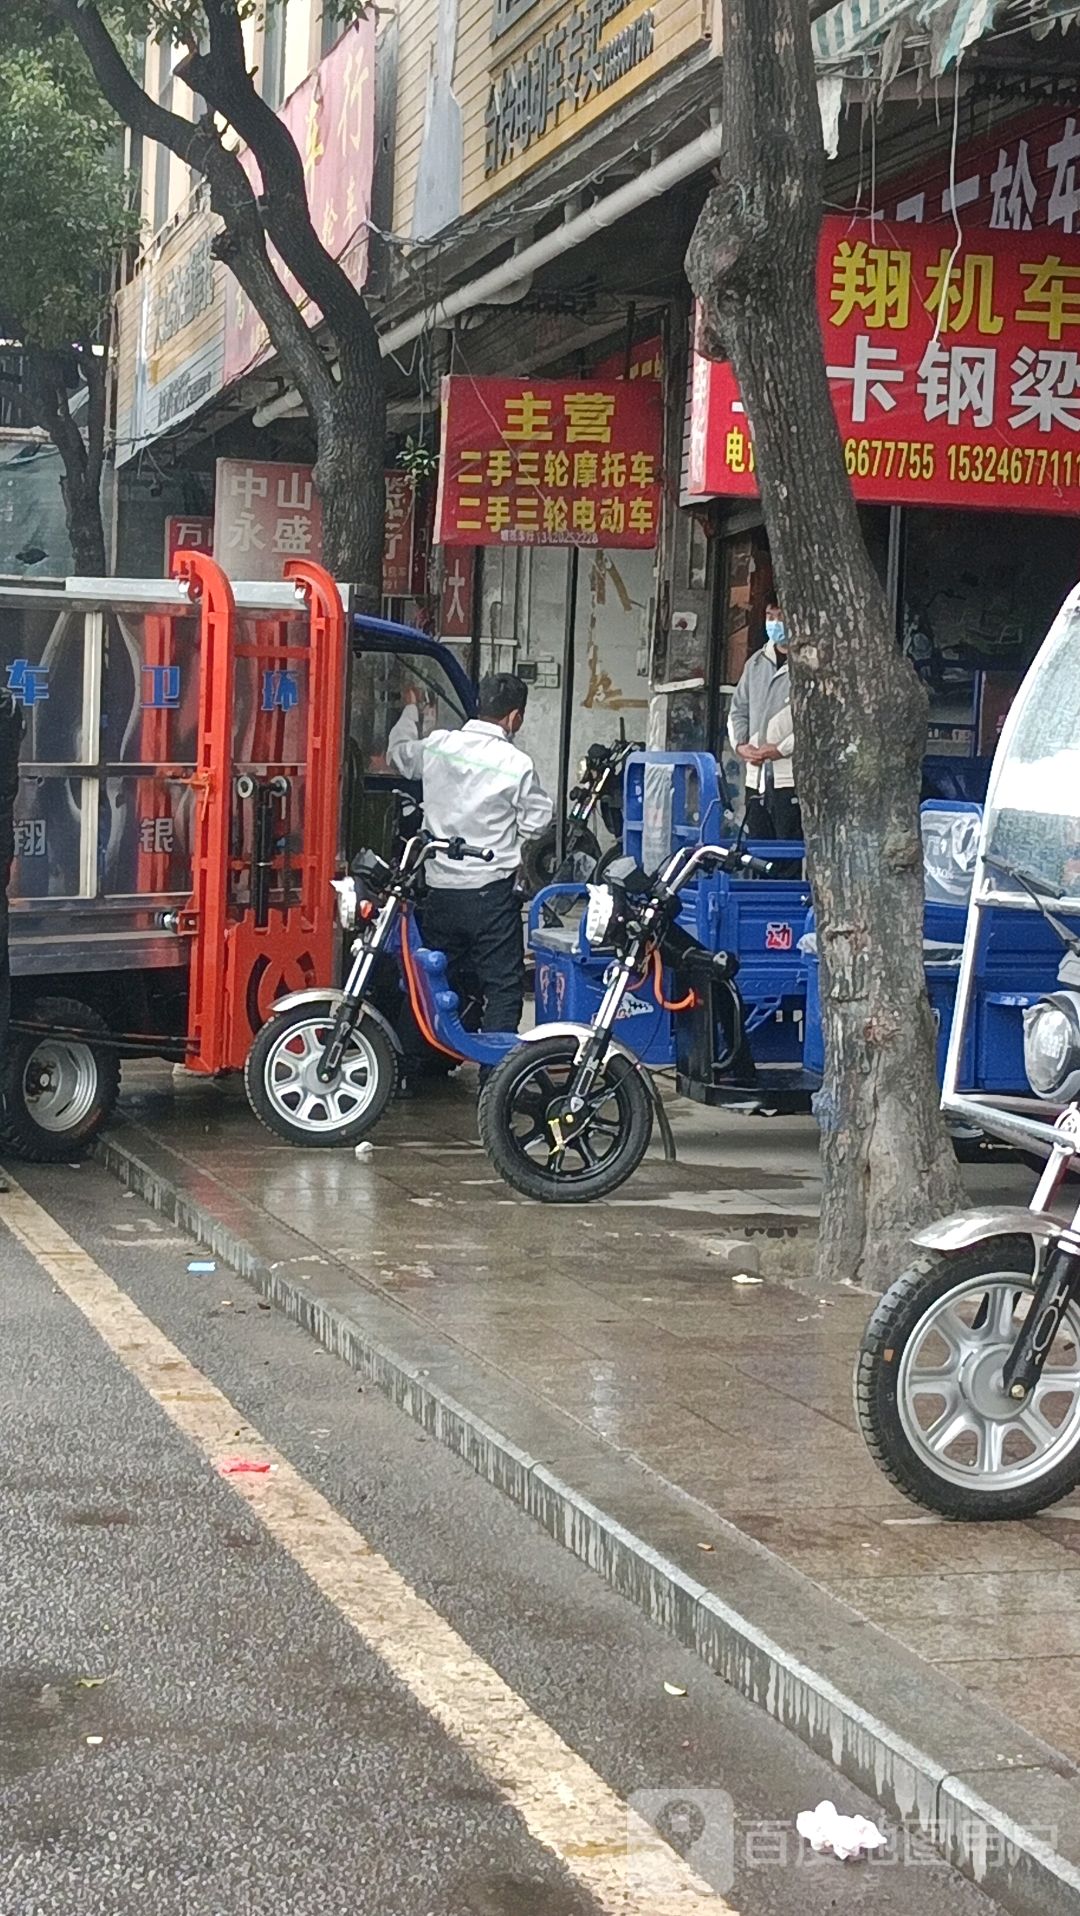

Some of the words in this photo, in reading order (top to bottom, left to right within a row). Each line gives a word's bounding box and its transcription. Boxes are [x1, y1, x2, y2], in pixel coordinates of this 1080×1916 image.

[502, 391, 616, 443] 主营
[457, 450, 655, 488] 二手三轮摩托车
[176, 523, 213, 547] 万
[456, 497, 653, 535] 二手三轮电动车
[141, 817, 173, 853] 银
